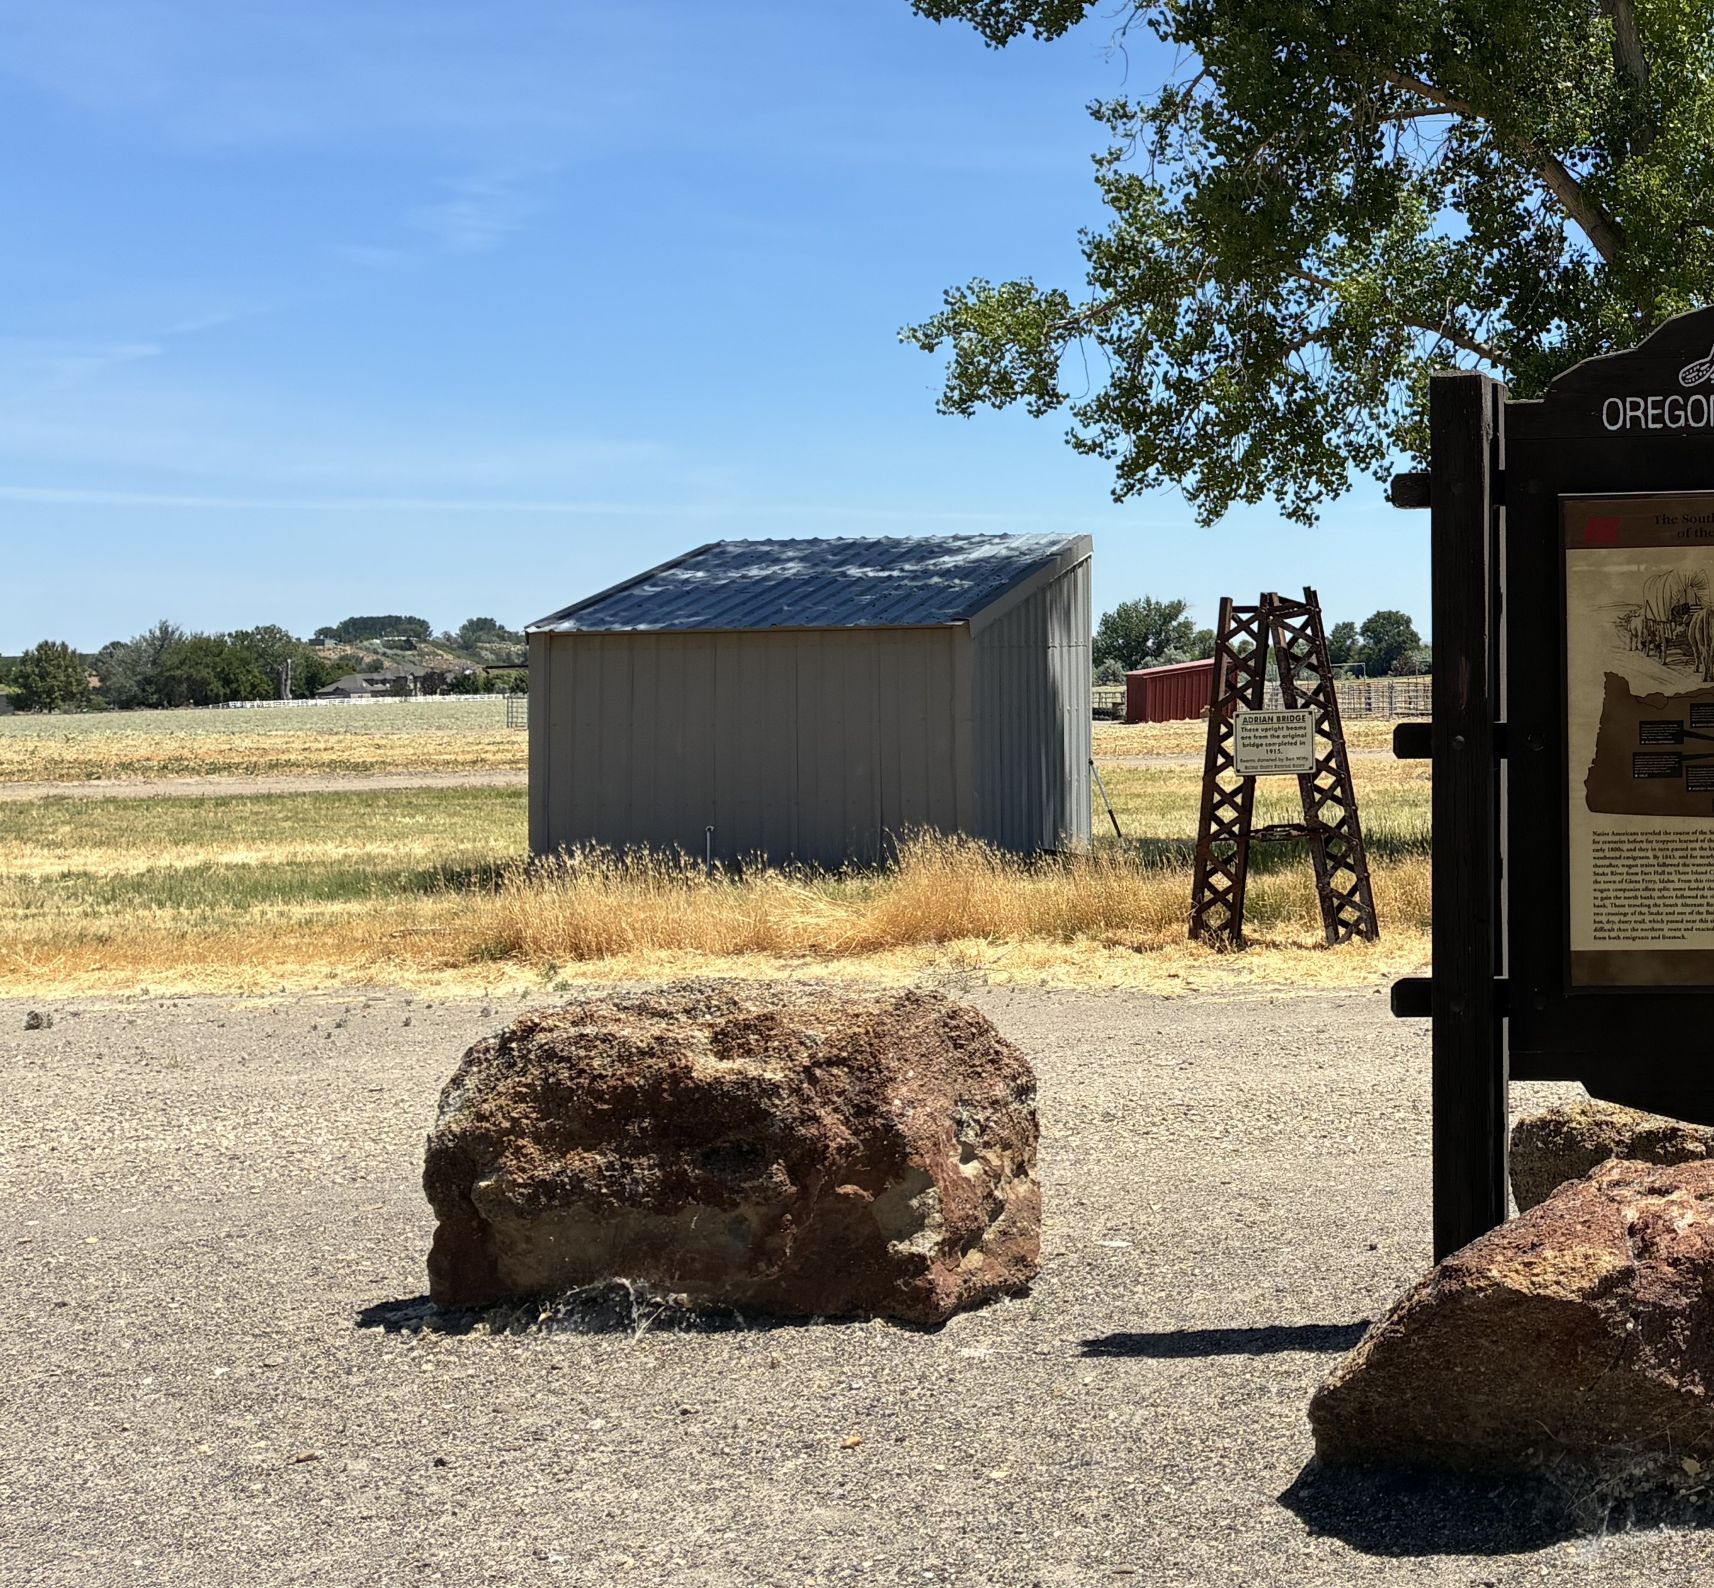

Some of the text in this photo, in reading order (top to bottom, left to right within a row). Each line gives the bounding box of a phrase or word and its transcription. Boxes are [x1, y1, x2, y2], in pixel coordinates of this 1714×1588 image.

[1655, 513, 1678, 524] The
[1677, 527, 1692, 538] of
[1637, 845, 1648, 853] they
[1652, 853, 1659, 861] By
